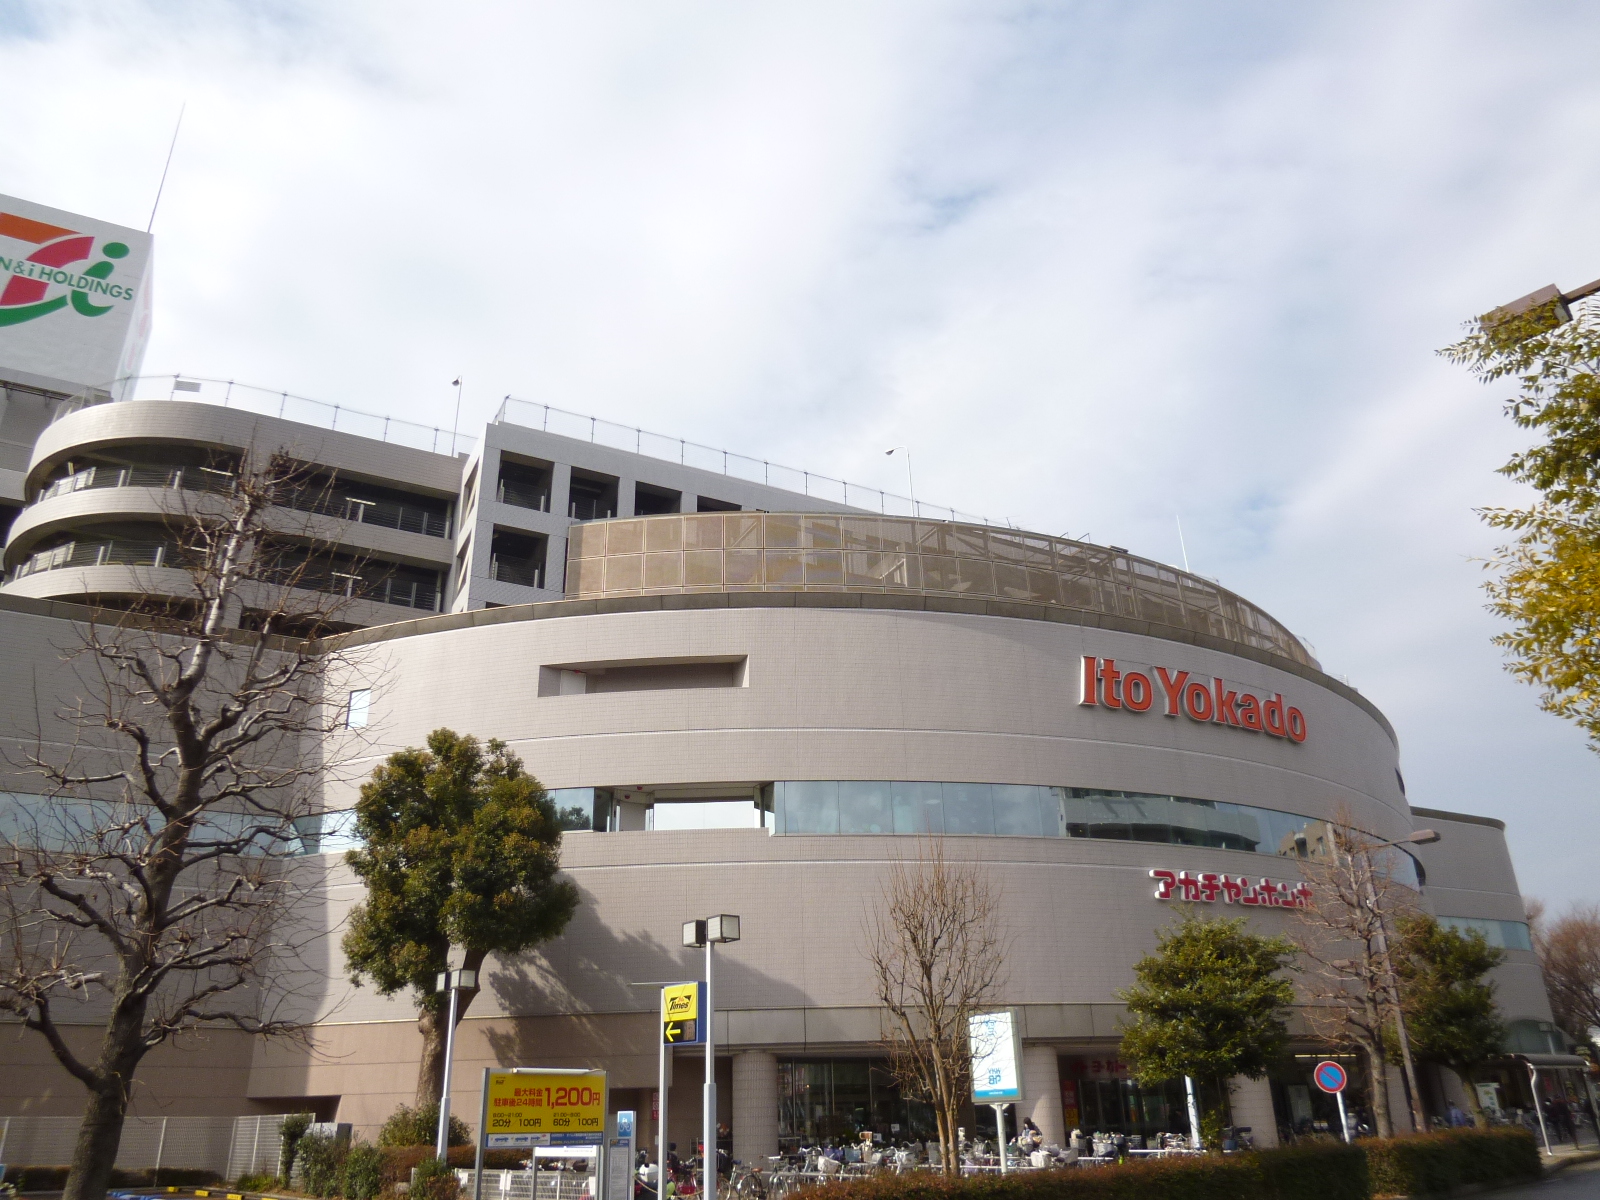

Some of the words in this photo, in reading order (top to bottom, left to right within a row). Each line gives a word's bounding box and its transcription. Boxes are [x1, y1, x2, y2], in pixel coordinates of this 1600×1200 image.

[38, 267, 133, 301] HOLDINGS
[514, 1088, 543, 1097] 最大料金
